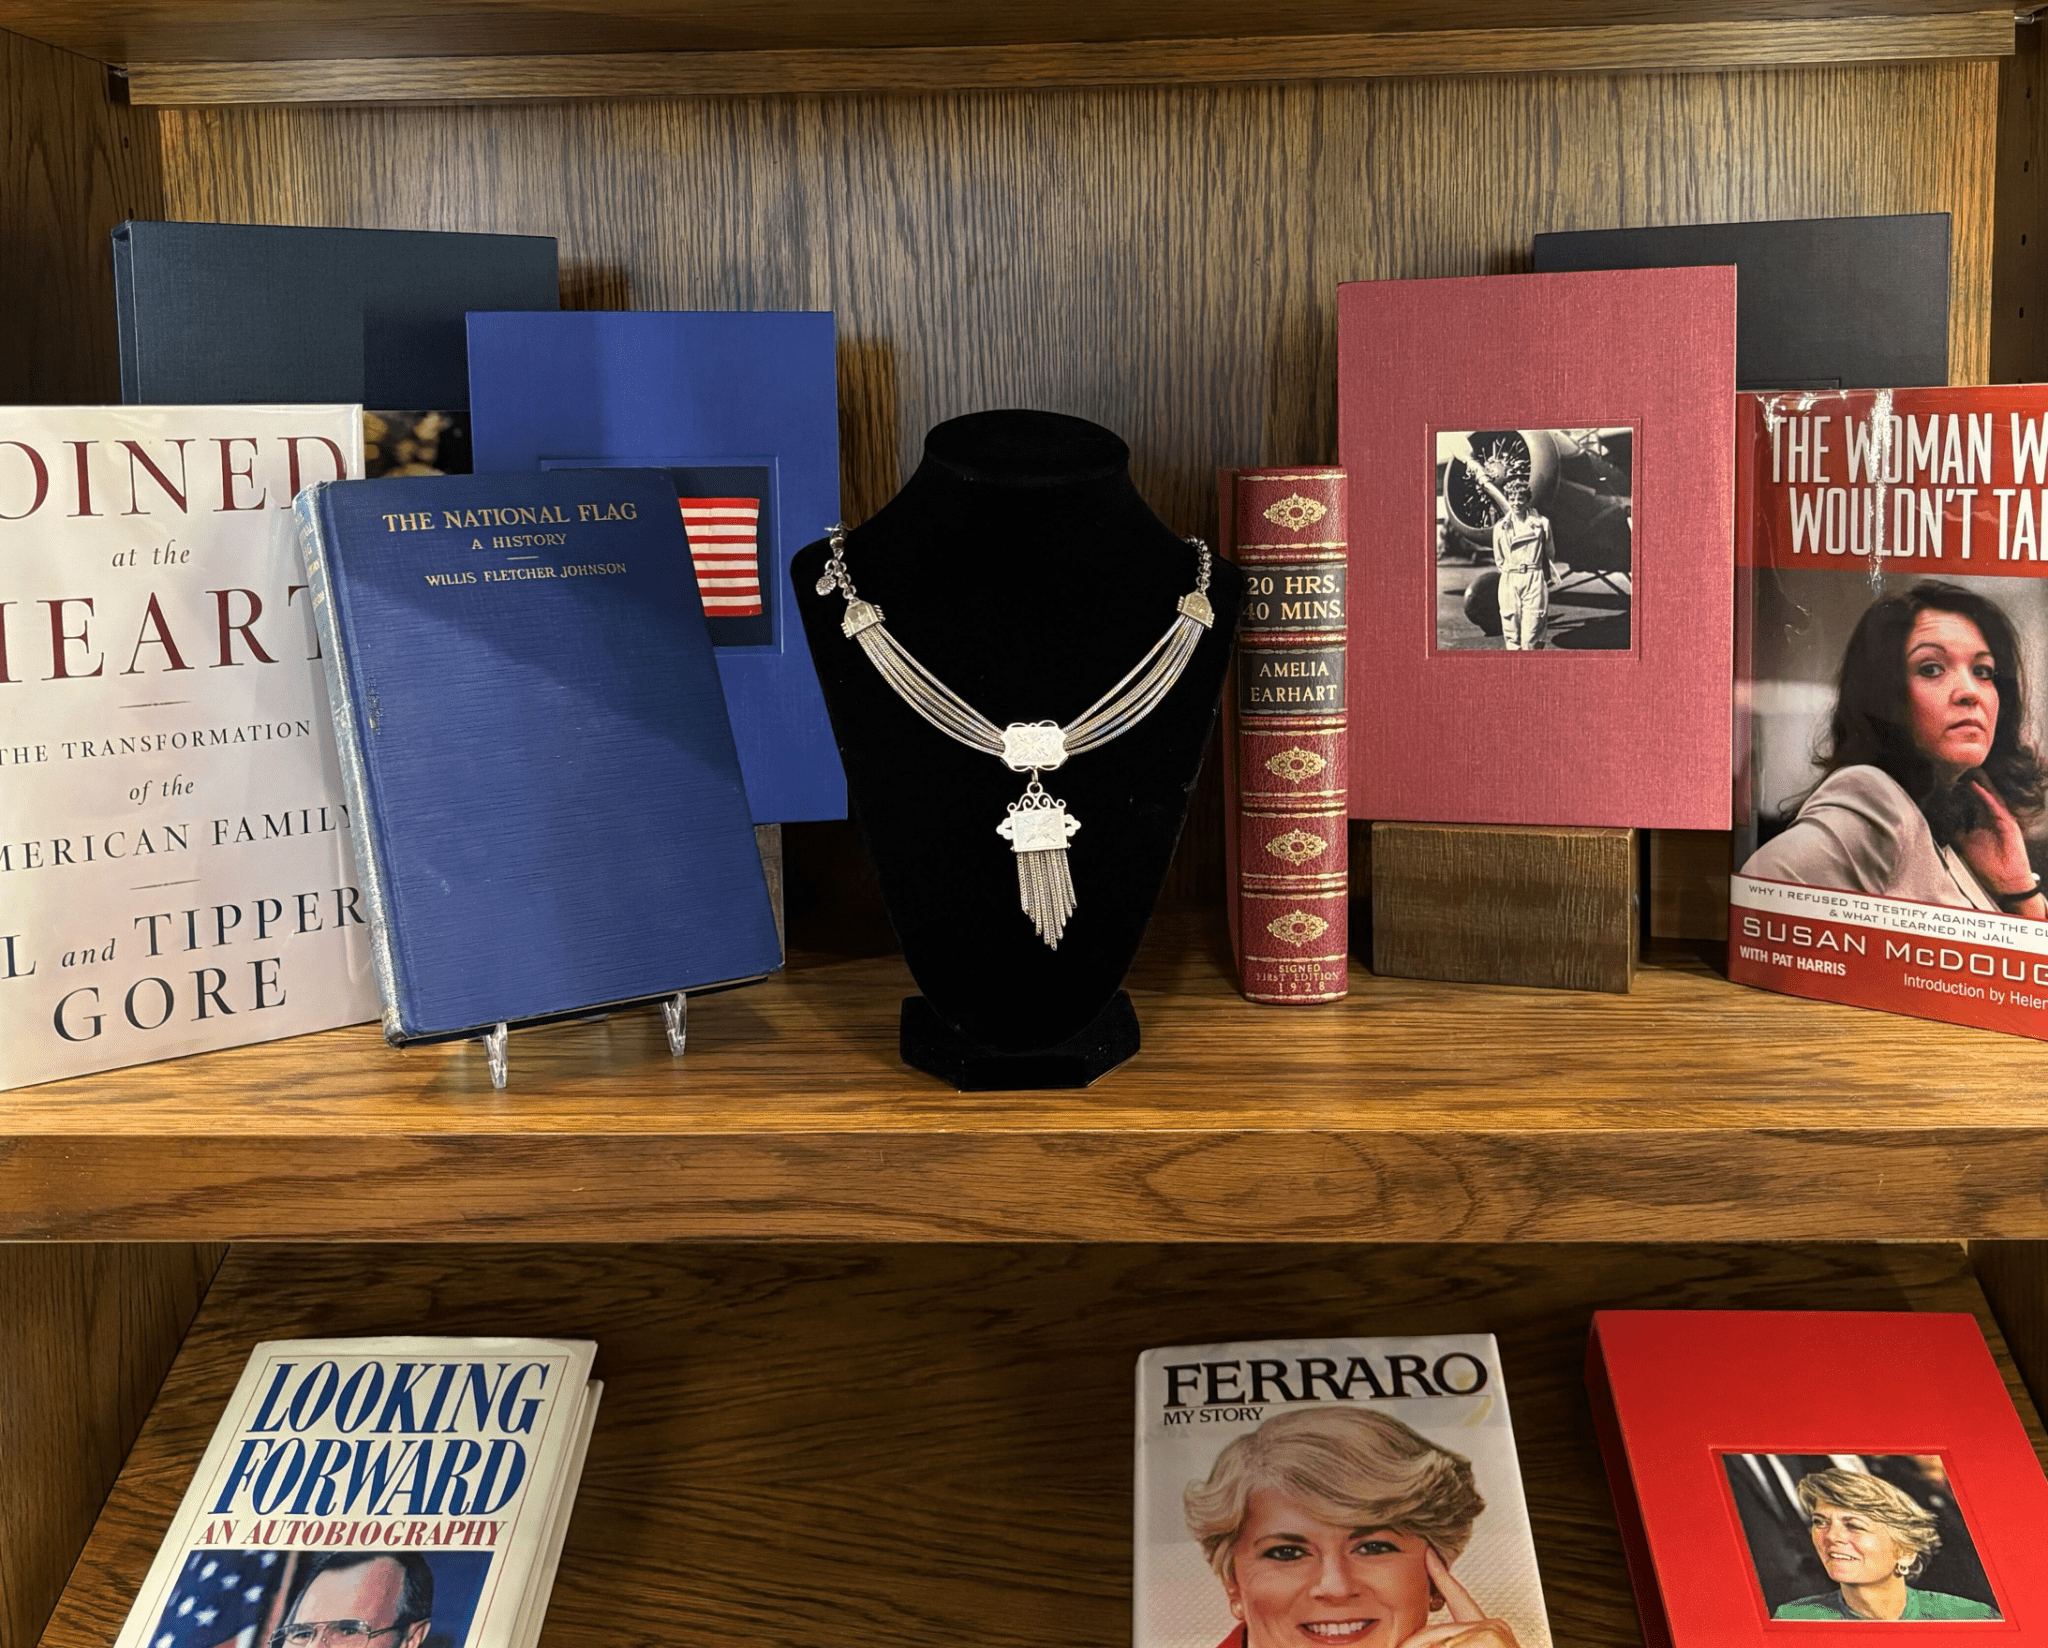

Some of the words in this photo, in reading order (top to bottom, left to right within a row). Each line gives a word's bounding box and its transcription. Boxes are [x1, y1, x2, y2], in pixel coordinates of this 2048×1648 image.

[1773, 416, 1831, 483] THE
[1845, 413, 1992, 484] WOMAN
[382, 511, 435, 532] THE
[443, 505, 570, 529] NATIONAL
[577, 502, 637, 523] FLAG
[1789, 487, 1978, 559] WOULDN'T
[112, 545, 137, 567] at
[153, 539, 190, 566] the
[471, 538, 483, 550] A
[492, 532, 566, 549] HISTORY
[424, 571, 478, 587] WILLIS
[483, 566, 557, 583] FLETCHER
[560, 562, 627, 579] JOHNSON
[1246, 576, 1274, 595] 20
[1285, 574, 1340, 595] HRS.
[1242, 602, 1270, 621] 40
[1281, 599, 1345, 621] MINS.
[0, 585, 323, 684] EAR
[1259, 661, 1330, 678] AMELIA
[1250, 684, 1338, 703] EARHART
[62, 720, 311, 760] TRANSFORMATION
[129, 780, 153, 805] of
[162, 774, 195, 797] the
[1749, 884, 1775, 897] WHY
[1787, 890, 1849, 907] REFUSED
[1852, 900, 1870, 911] TO
[1874, 903, 1928, 918] TESTIFY
[1932, 911, 1996, 929] AGAINST
[2000, 921, 2029, 935] THE
[61, 938, 116, 968] and
[134, 886, 366, 958] TIPPER
[1743, 917, 1867, 956] SUSAN
[1829, 908, 1839, 918] &
[1842, 909, 1878, 923] WHAT
[1892, 917, 1957, 936] LEARNED
[1962, 928, 1977, 939] IN
[1983, 933, 2015, 945] JAIL
[1279, 963, 1321, 973] SIGNED
[1294, 971, 1340, 981] EDITION
[1740, 945, 1768, 963] WITH
[1772, 951, 1793, 968] PAT
[1797, 956, 1847, 977] HARRIS
[53, 957, 287, 1042] GORE
[1904, 973, 1984, 999] Introduction
[1989, 987, 2006, 1005] by
[1163, 1352, 1489, 1409] FERRARO
[246, 1361, 550, 1434] LOOKING
[1164, 1410, 1195, 1426] MY
[1200, 1406, 1264, 1423] STORY
[207, 1437, 527, 1516] FORWARD
[194, 1520, 240, 1546] AN
[243, 1520, 508, 1547] AUTOBIOGRAPHY
